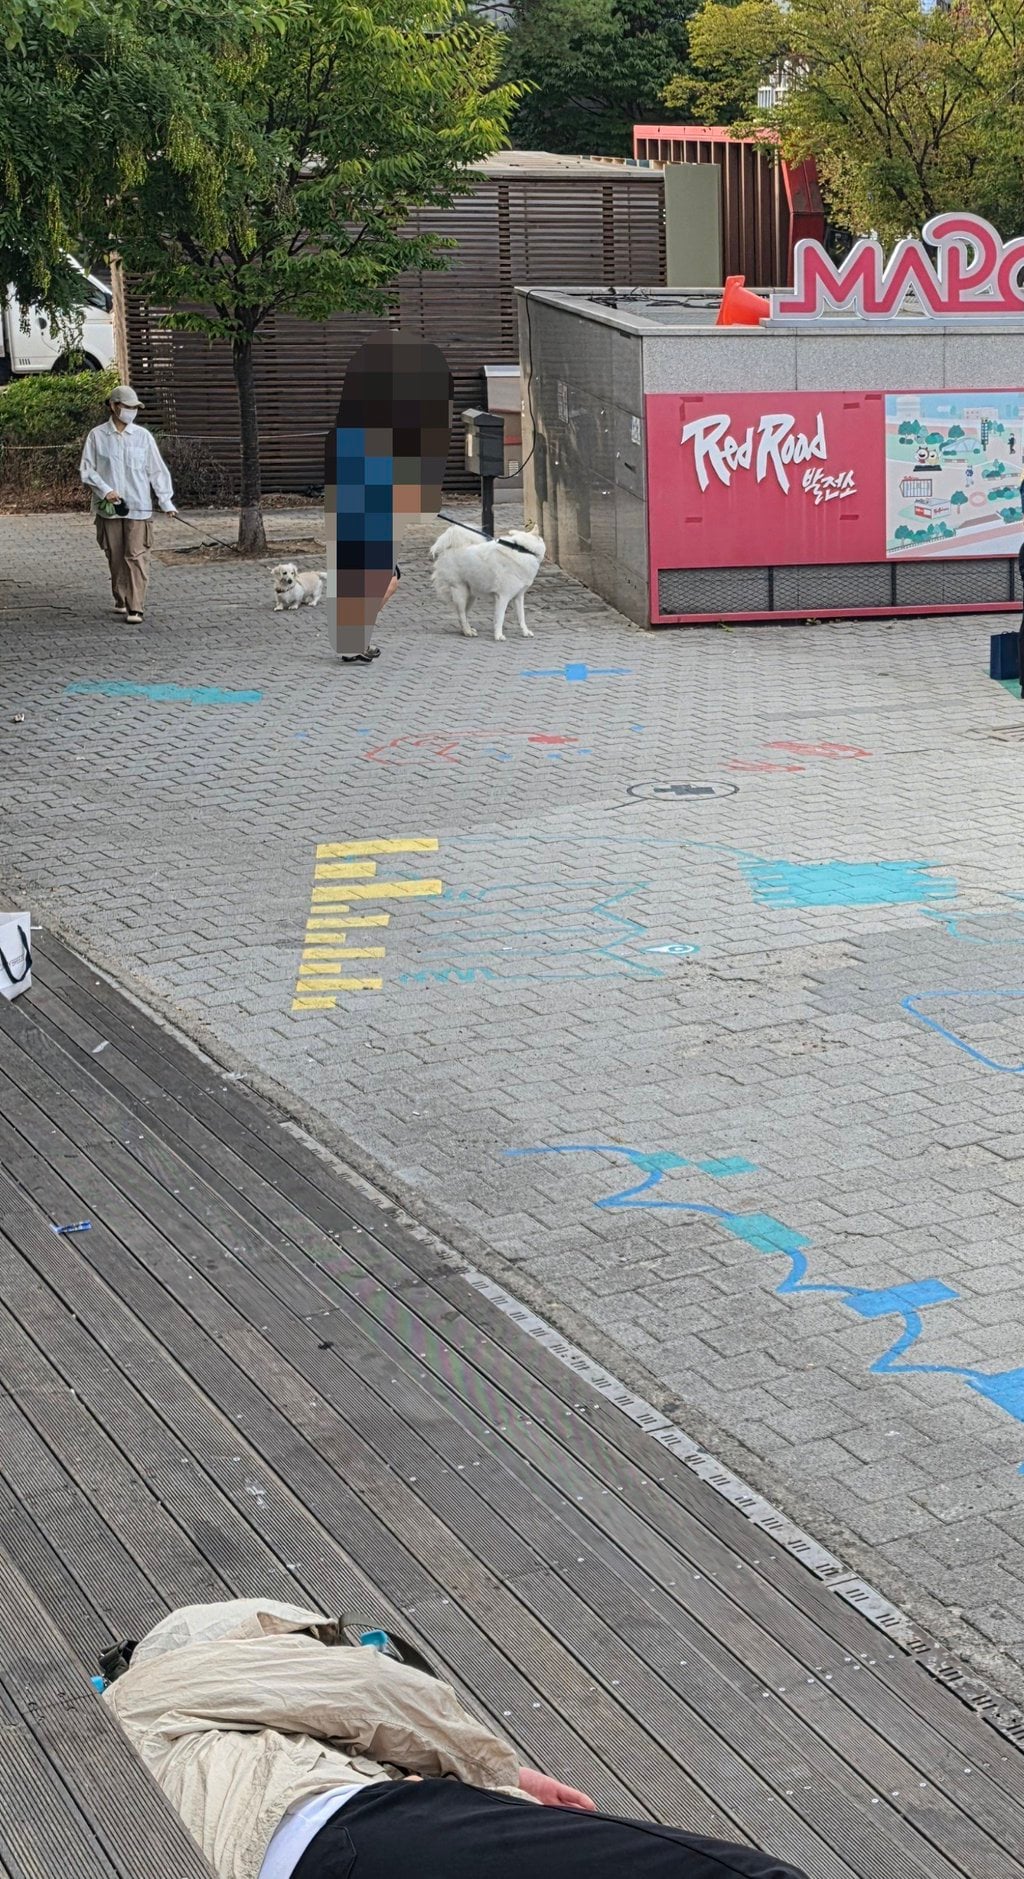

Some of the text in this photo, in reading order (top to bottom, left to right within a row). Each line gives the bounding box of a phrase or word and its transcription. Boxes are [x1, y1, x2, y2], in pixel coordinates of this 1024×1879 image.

[680, 411, 828, 496] Red Road
[802, 467, 858, 505] 발전소
